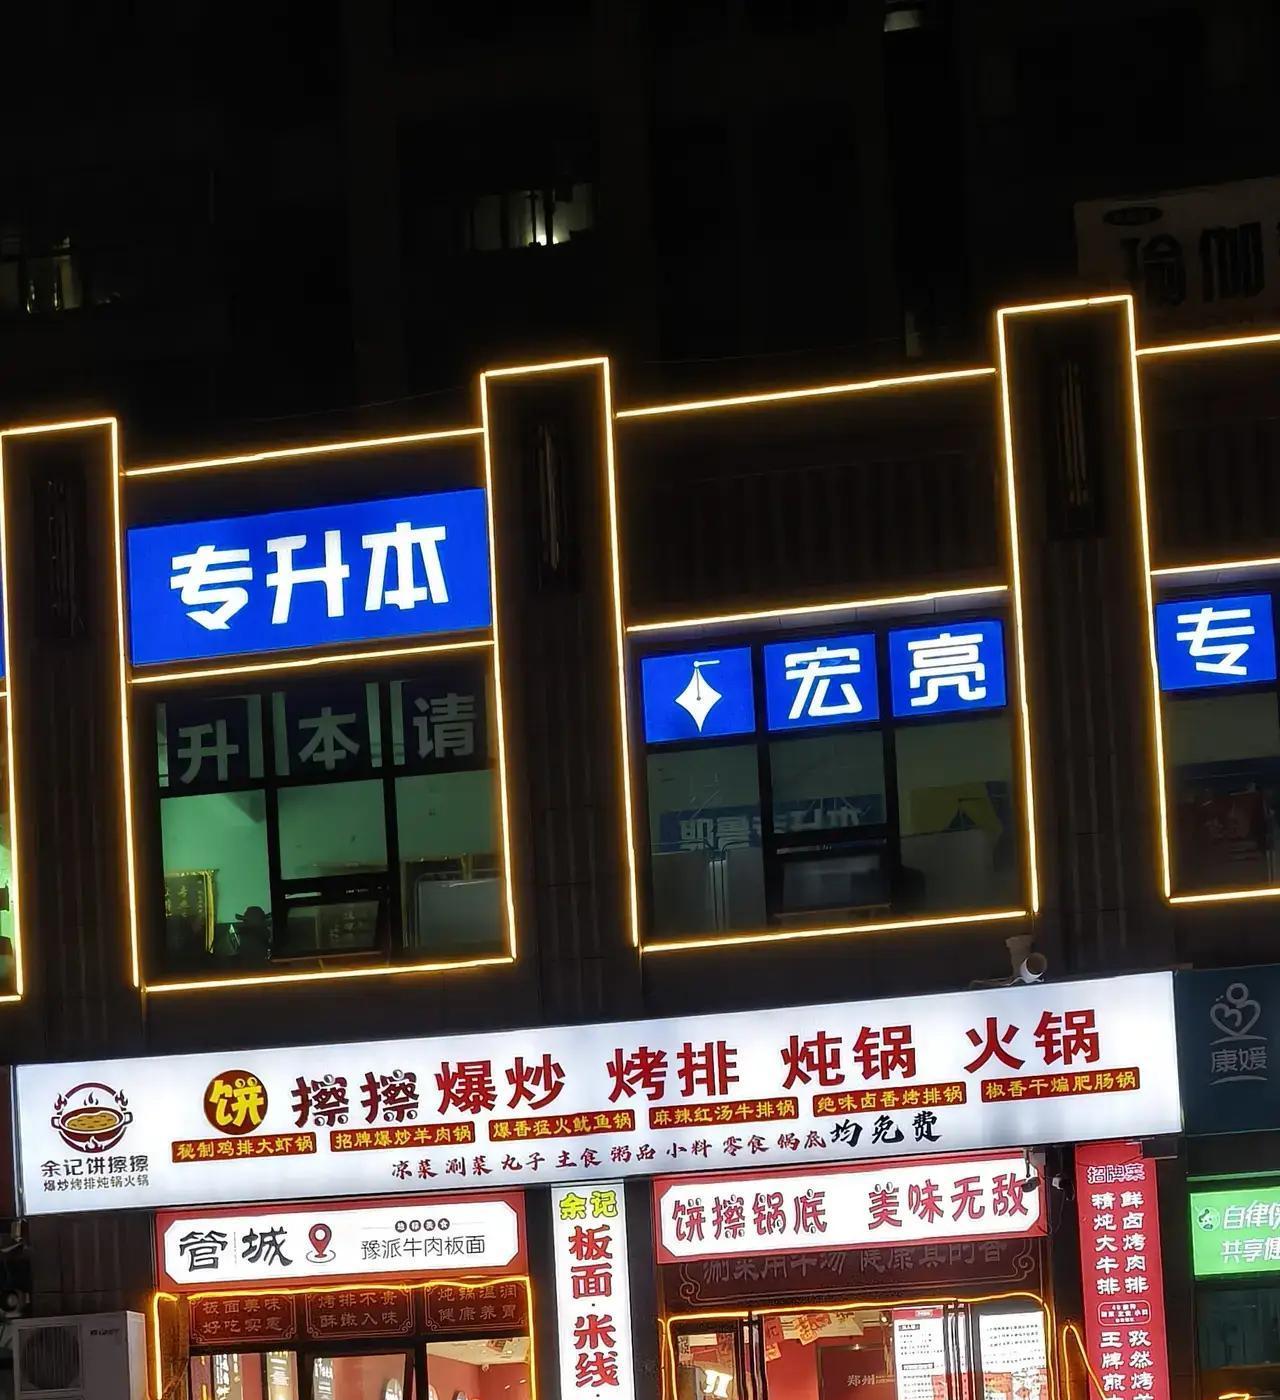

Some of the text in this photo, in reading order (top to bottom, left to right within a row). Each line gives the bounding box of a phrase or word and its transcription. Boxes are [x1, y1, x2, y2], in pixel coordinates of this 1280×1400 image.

[170, 521, 450, 630] 专升本
[1176, 606, 1256, 676] 专
[785, 632, 986, 720] 宏亮
[178, 693, 478, 785] 升本请
[606, 1040, 740, 1104] 烤排
[781, 1025, 917, 1089] 炖锅
[964, 1008, 1101, 1074] 火锅
[177, 1070, 1136, 1161] 秘制鸡排大虾锅 招牌爆炒羊肉锅 爆香猛火鱿鱼锅 麻辣红汤牛排锅 绝味卤香烤排锅 椒香干煸肥肠锅
[40, 1155, 149, 1178] 余记饼擦擦
[43, 1174, 150, 1192] 爆炒烤排炖锅火锅
[1087, 1163, 1146, 1184] 招牌菜
[559, 1189, 619, 1221] 余记
[672, 1172, 1028, 1242] 饼擦锅底 美味无敌
[179, 1226, 294, 1272] 管城
[360, 1234, 486, 1261] 豫派牛肉板面
[1091, 1192, 1121, 1296] 精炖大牛排
[1120, 1190, 1150, 1295] 鲜卤烤肉排
[203, 1316, 283, 1335] 好吃实惠
[318, 1289, 399, 1309] 烤排不贵
[438, 1303, 517, 1323] 健康养胃
